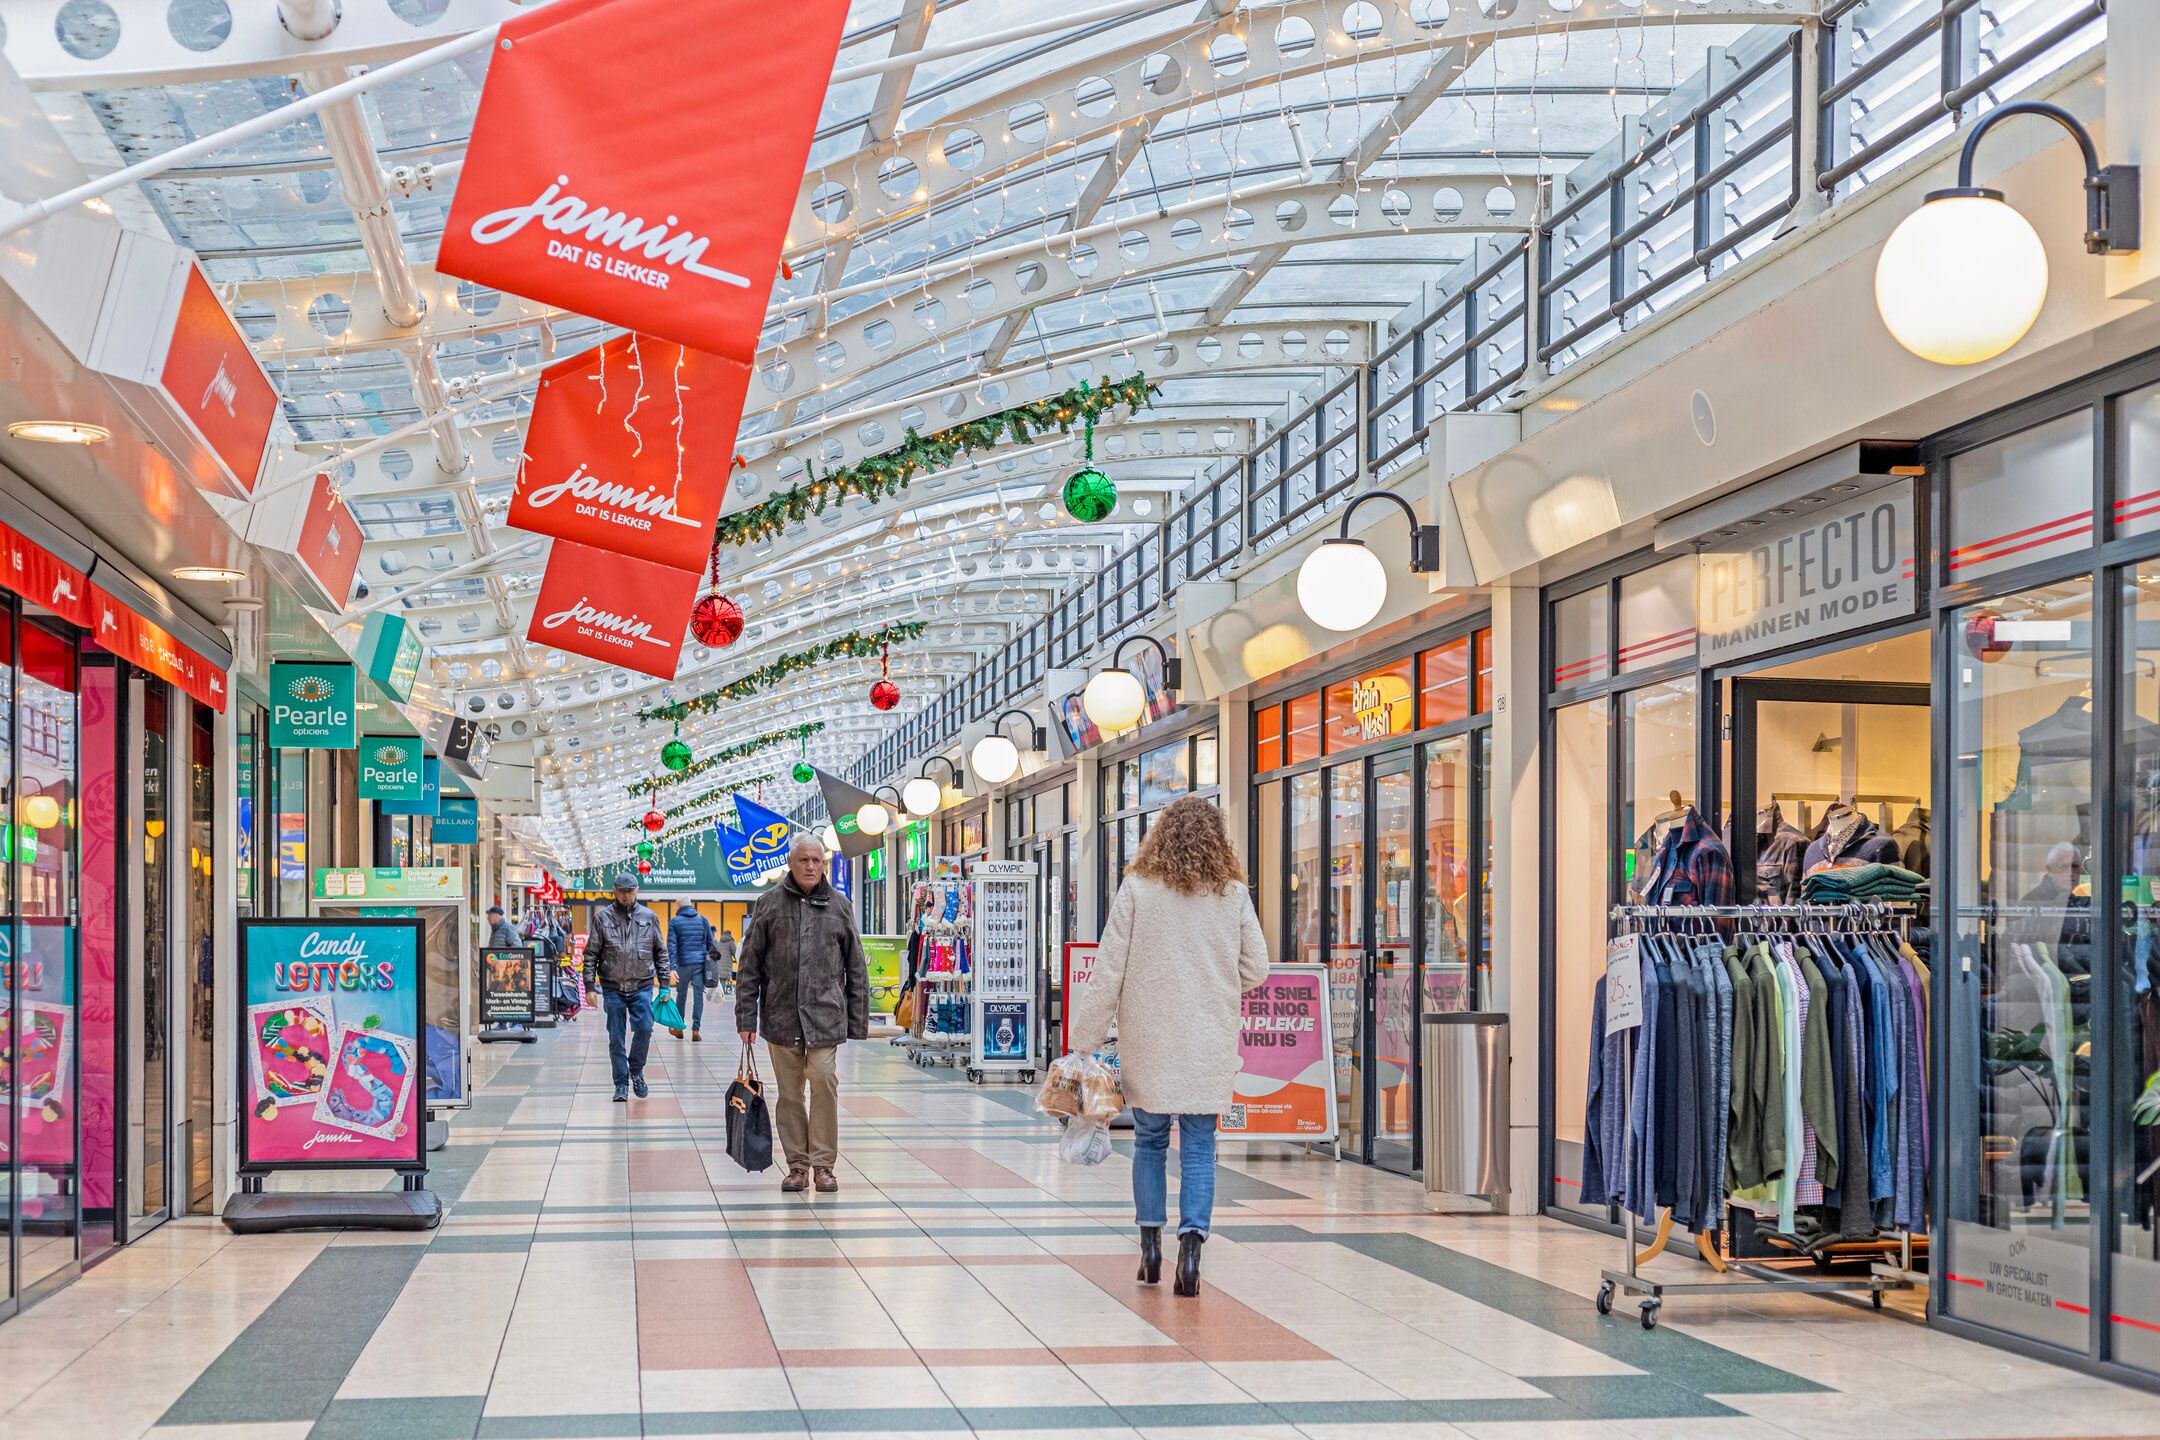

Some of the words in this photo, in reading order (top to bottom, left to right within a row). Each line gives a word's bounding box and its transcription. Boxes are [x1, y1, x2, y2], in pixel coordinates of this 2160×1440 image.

[471, 175, 751, 289] jamin
[547, 239, 583, 262] DAT
[584, 252, 602, 270] IS
[605, 258, 671, 290] LEKKER
[528, 464, 702, 528] jamin
[575, 503, 598, 516] DAT
[599, 510, 610, 521] IS
[612, 512, 652, 531] LEKKER
[1711, 502, 1897, 624] PERFECTO
[543, 597, 671, 647] jamin
[1711, 607, 1811, 650] MANNEN
[1820, 583, 1898, 619] MODE
[578, 626, 594, 636] DAT
[595, 630, 603, 639] IS
[604, 633, 634, 649] LEKKER
[1352, 680, 1380, 713] Brain
[274, 705, 348, 726] Pearle
[1361, 703, 1391, 740] Wash
[293, 728, 329, 736] opticiens
[363, 767, 418, 783] Pearle
[436, 818, 475, 826] BELLAMO
[988, 864, 1024, 873] OLYMPIC
[300, 932, 369, 963] Candy
[511, 998, 532, 1006] Vintage
[1274, 986, 1317, 1000] SNEL
[990, 1004, 1021, 1013] OLYMPIC
[1249, 1002, 1270, 1016] ER
[1273, 1002, 1309, 1016] NOG
[1254, 1017, 1315, 1031] PLEKJE
[1280, 1033, 1297, 1047] IS
[2009, 1239, 2027, 1257] OOK
[1989, 1260, 2002, 1275] UW
[2003, 1264, 2049, 1287] SPECIALIST
[1987, 1282, 1996, 1293] IN
[1996, 1283, 2023, 1301] GROTE
[2024, 1289, 2052, 1309] MATEN
